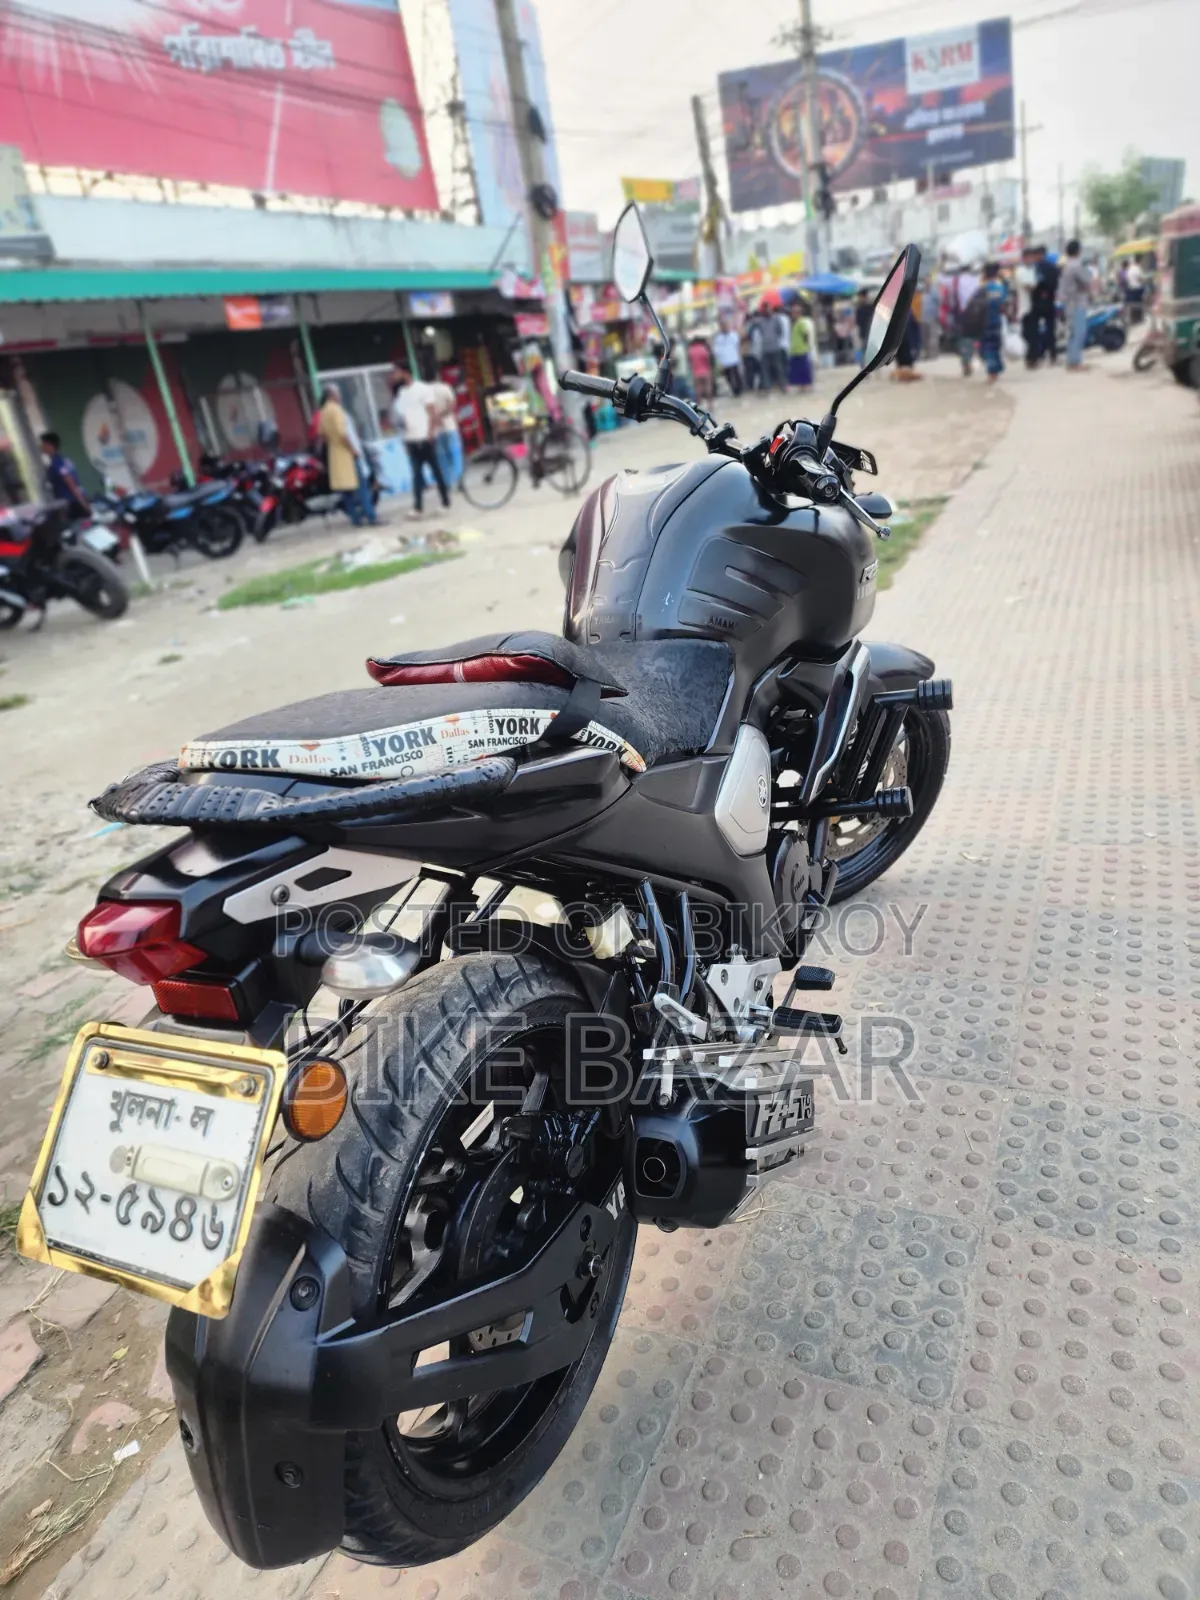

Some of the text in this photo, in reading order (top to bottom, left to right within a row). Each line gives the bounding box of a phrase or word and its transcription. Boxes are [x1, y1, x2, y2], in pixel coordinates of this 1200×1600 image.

[441, 727, 470, 739] Dallas
[495, 717, 540, 735] YORK
[371, 726, 437, 757] YORK
[468, 736, 528, 749] SAN FRANCISCO
[206, 749, 281, 769] YORK
[289, 754, 333, 764] Dallas
[329, 764, 358, 777] SAN
[361, 749, 423, 772] FRANCISCO
[47, 1164, 224, 1250] ১২-৫৯৪৬
